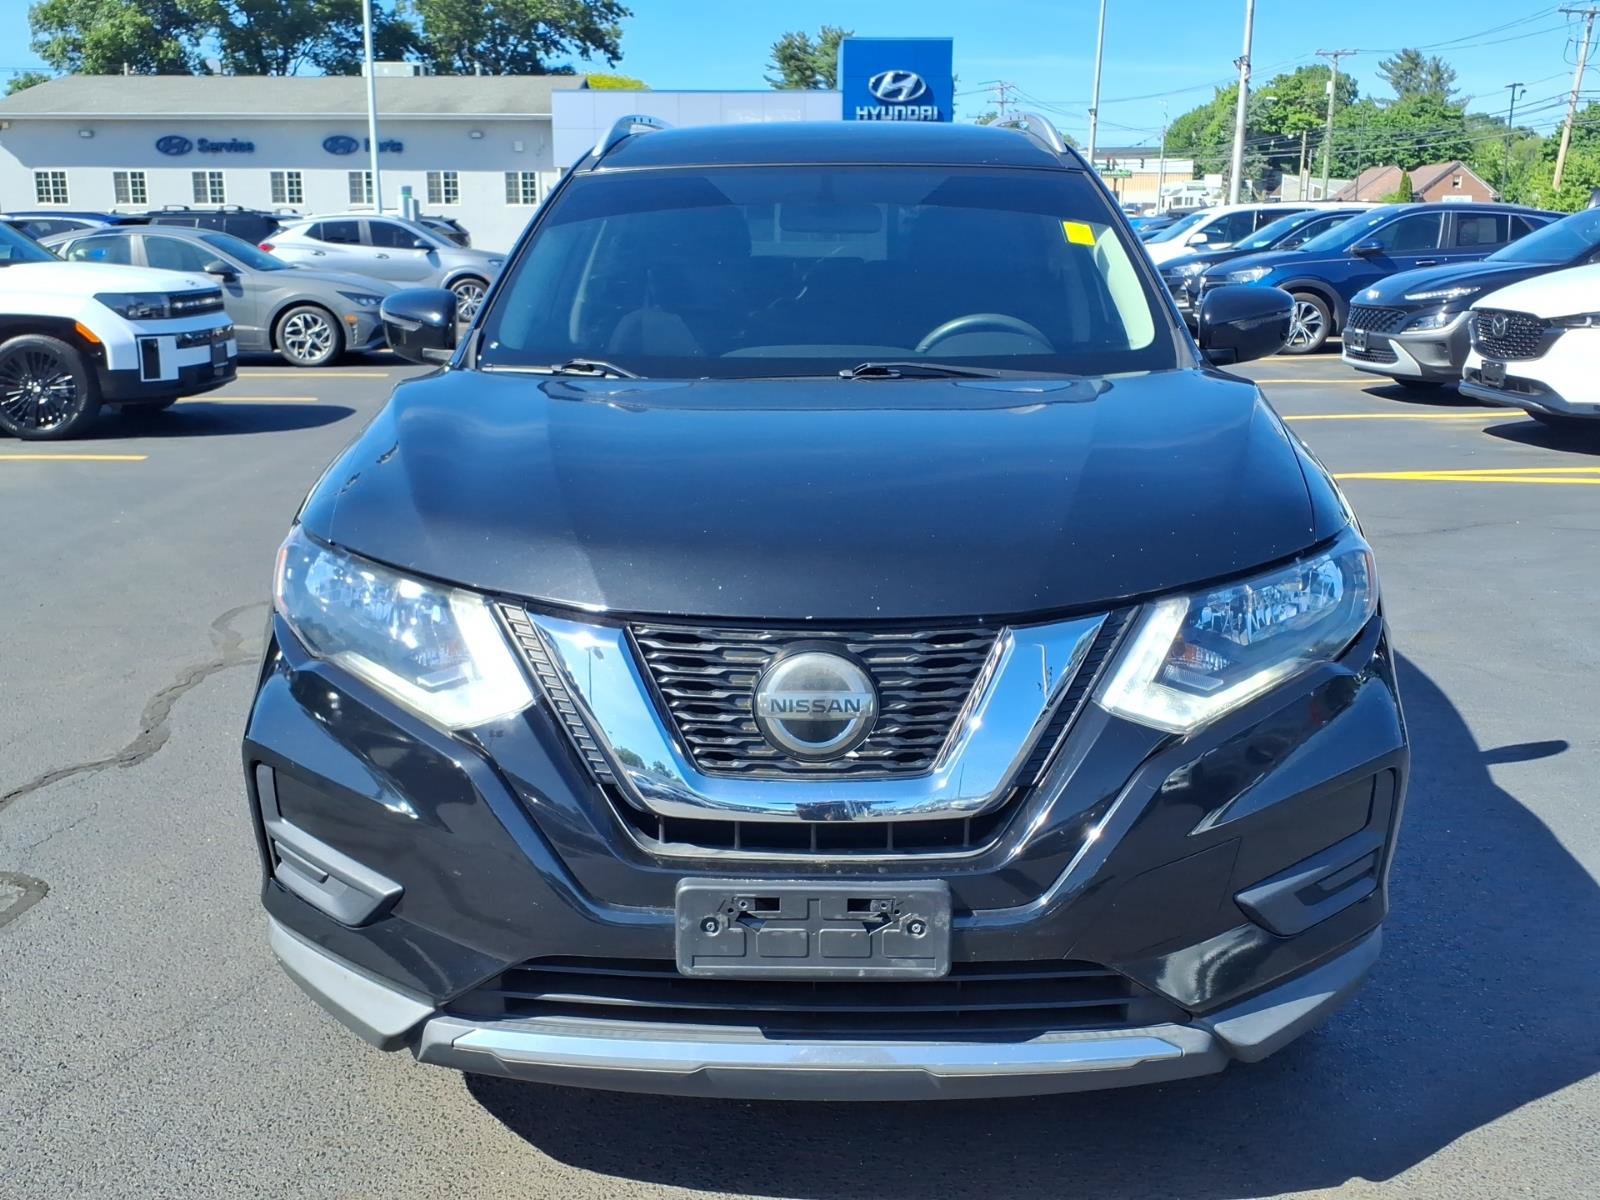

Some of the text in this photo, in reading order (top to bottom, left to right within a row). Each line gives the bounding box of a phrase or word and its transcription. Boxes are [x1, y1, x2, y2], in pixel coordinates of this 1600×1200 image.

[856, 105, 938, 121] HYUNDAI
[197, 138, 254, 153] Service
[770, 698, 861, 713] NISSAN
